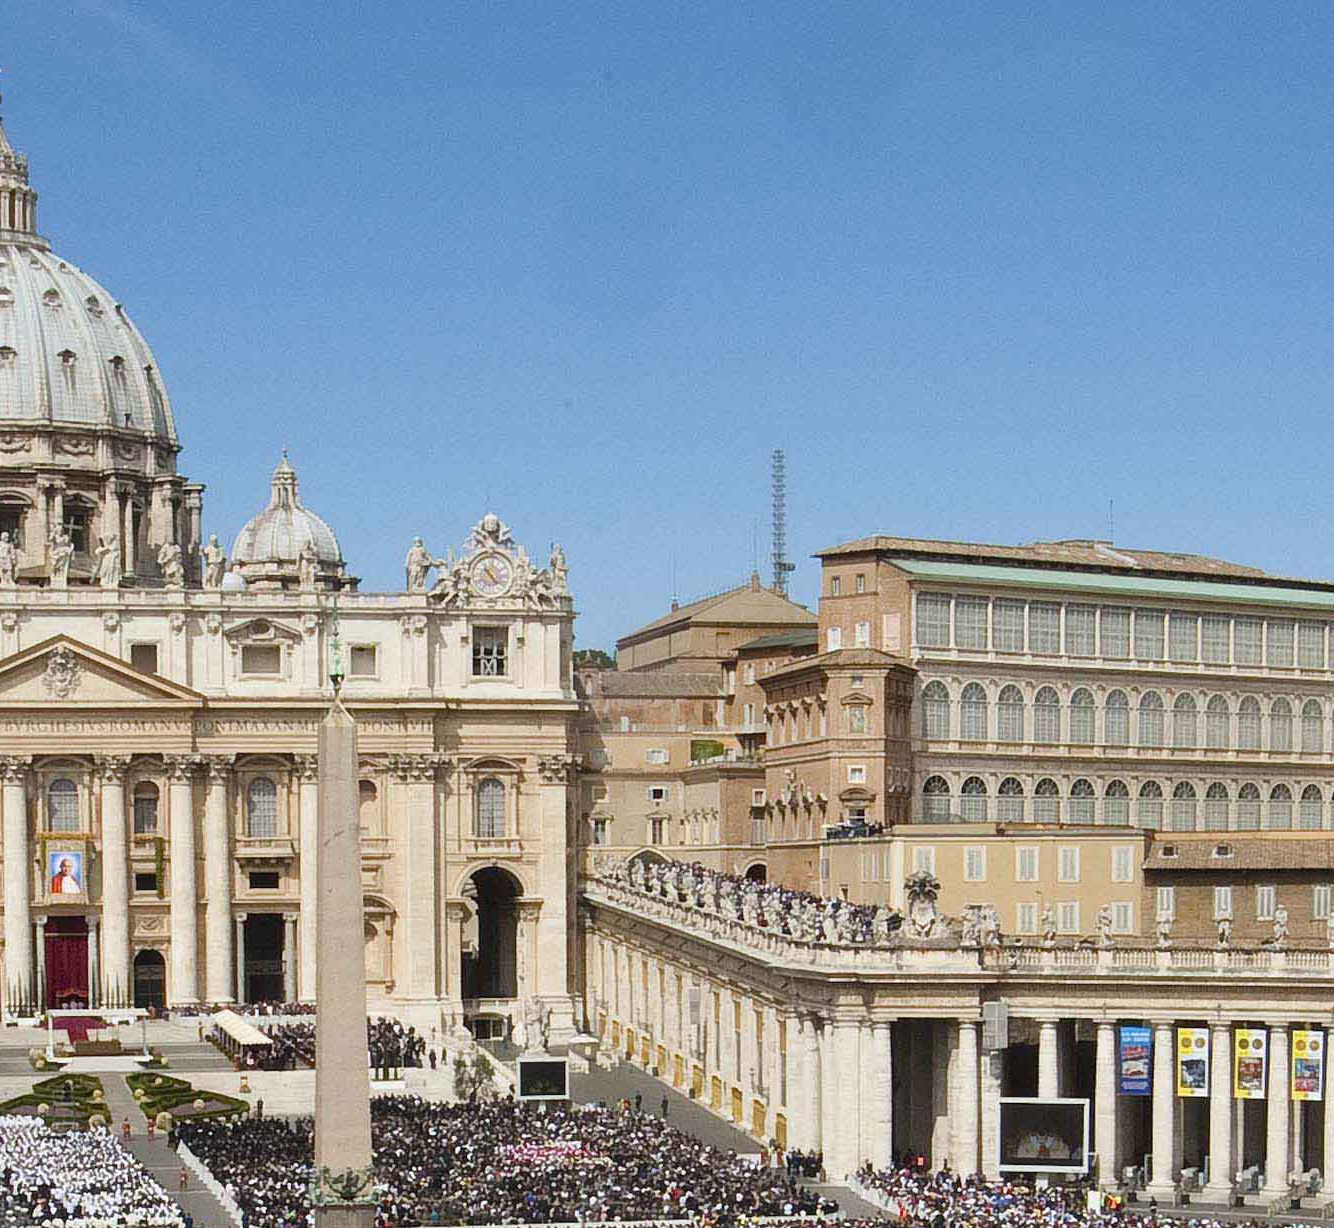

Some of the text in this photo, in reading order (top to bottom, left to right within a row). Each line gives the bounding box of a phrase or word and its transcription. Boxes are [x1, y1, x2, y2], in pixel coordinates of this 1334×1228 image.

[110, 719, 191, 732] ROMANVS
[195, 719, 233, 732] PONT
[364, 720, 404, 732] PONT
